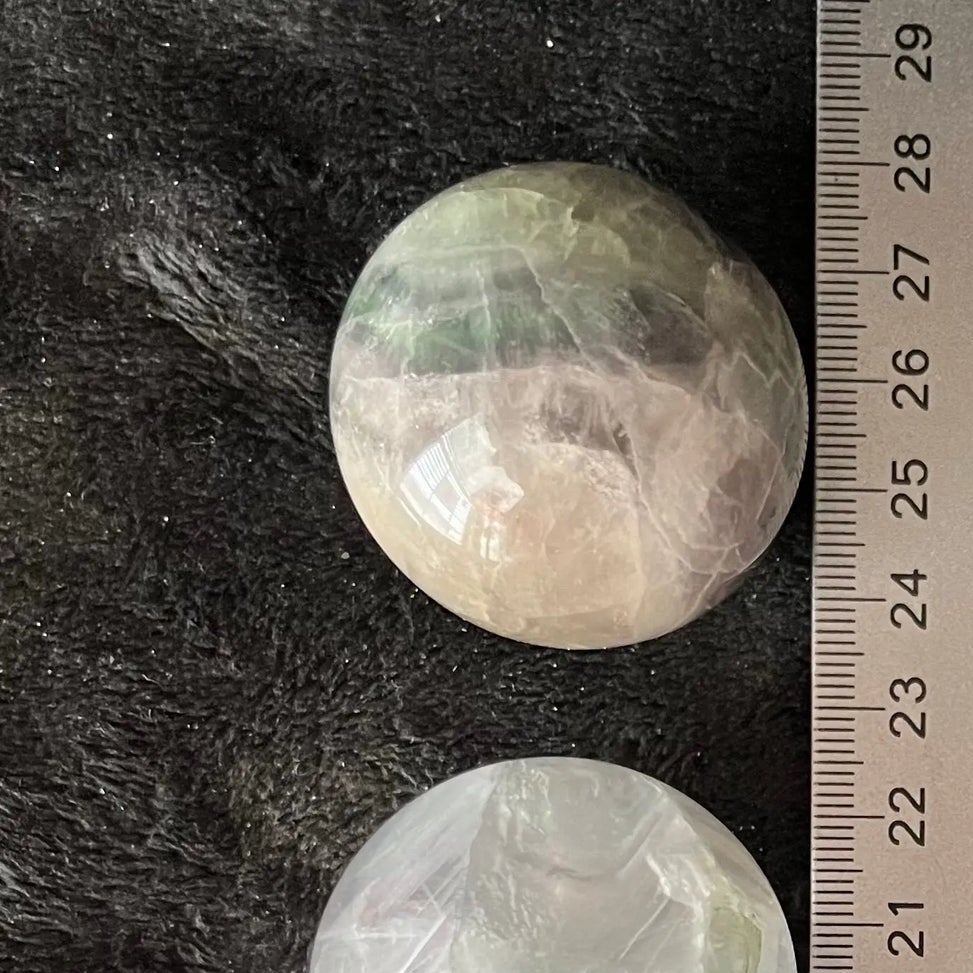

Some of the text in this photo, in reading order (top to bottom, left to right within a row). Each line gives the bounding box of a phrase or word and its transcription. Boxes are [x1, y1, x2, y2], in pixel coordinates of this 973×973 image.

[895, 24, 932, 82] 29
[894, 134, 931, 193] 28
[893, 244, 930, 302] 27
[892, 349, 929, 411] 26
[891, 459, 928, 520] 25
[890, 569, 927, 630] 24
[889, 677, 926, 739] 23
[888, 788, 925, 846] 22
[887, 903, 925, 957] 21
